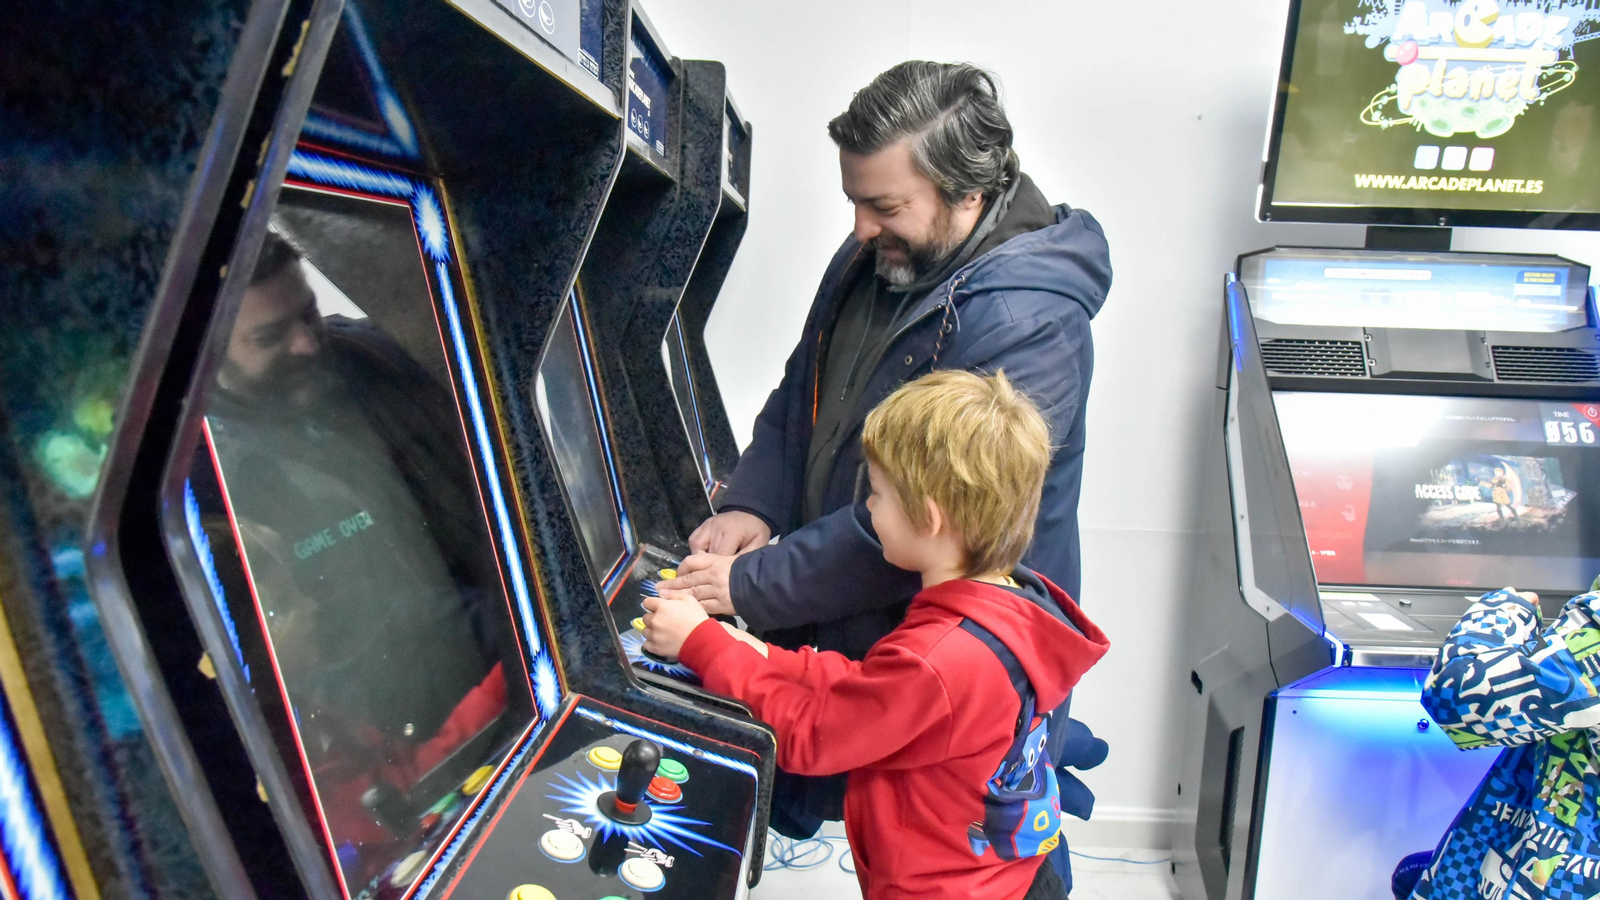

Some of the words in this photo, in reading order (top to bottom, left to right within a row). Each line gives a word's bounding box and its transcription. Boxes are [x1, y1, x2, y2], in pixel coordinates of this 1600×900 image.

[1354, 174, 1544, 194] WWW.ARCADEPLANET.ES
[1544, 421, 1596, 444] 056
[1414, 484, 1454, 499] ACCESS
[1454, 485, 1482, 501] CODE
[294, 528, 335, 560] GAME
[339, 510, 373, 538] OVER
